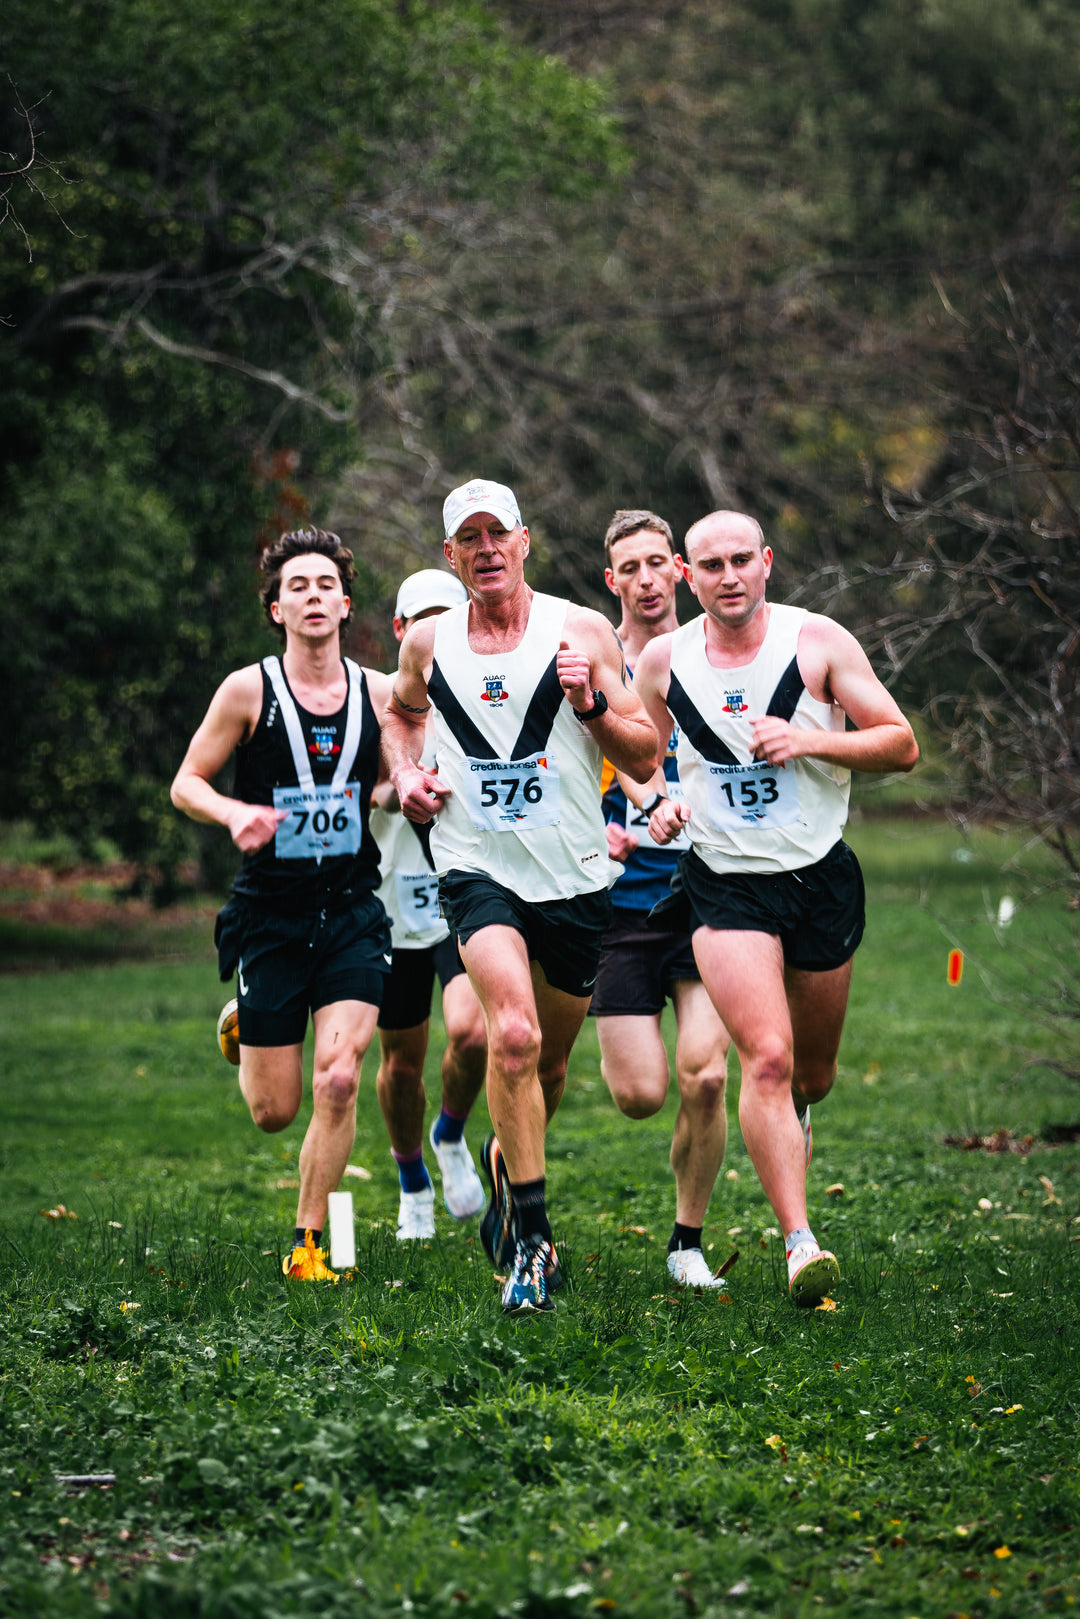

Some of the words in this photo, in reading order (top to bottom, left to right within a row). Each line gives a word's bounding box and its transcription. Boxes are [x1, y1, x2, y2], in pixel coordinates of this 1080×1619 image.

[481, 776, 543, 808] 576
[720, 777, 779, 808] 153
[292, 807, 349, 836] 706
